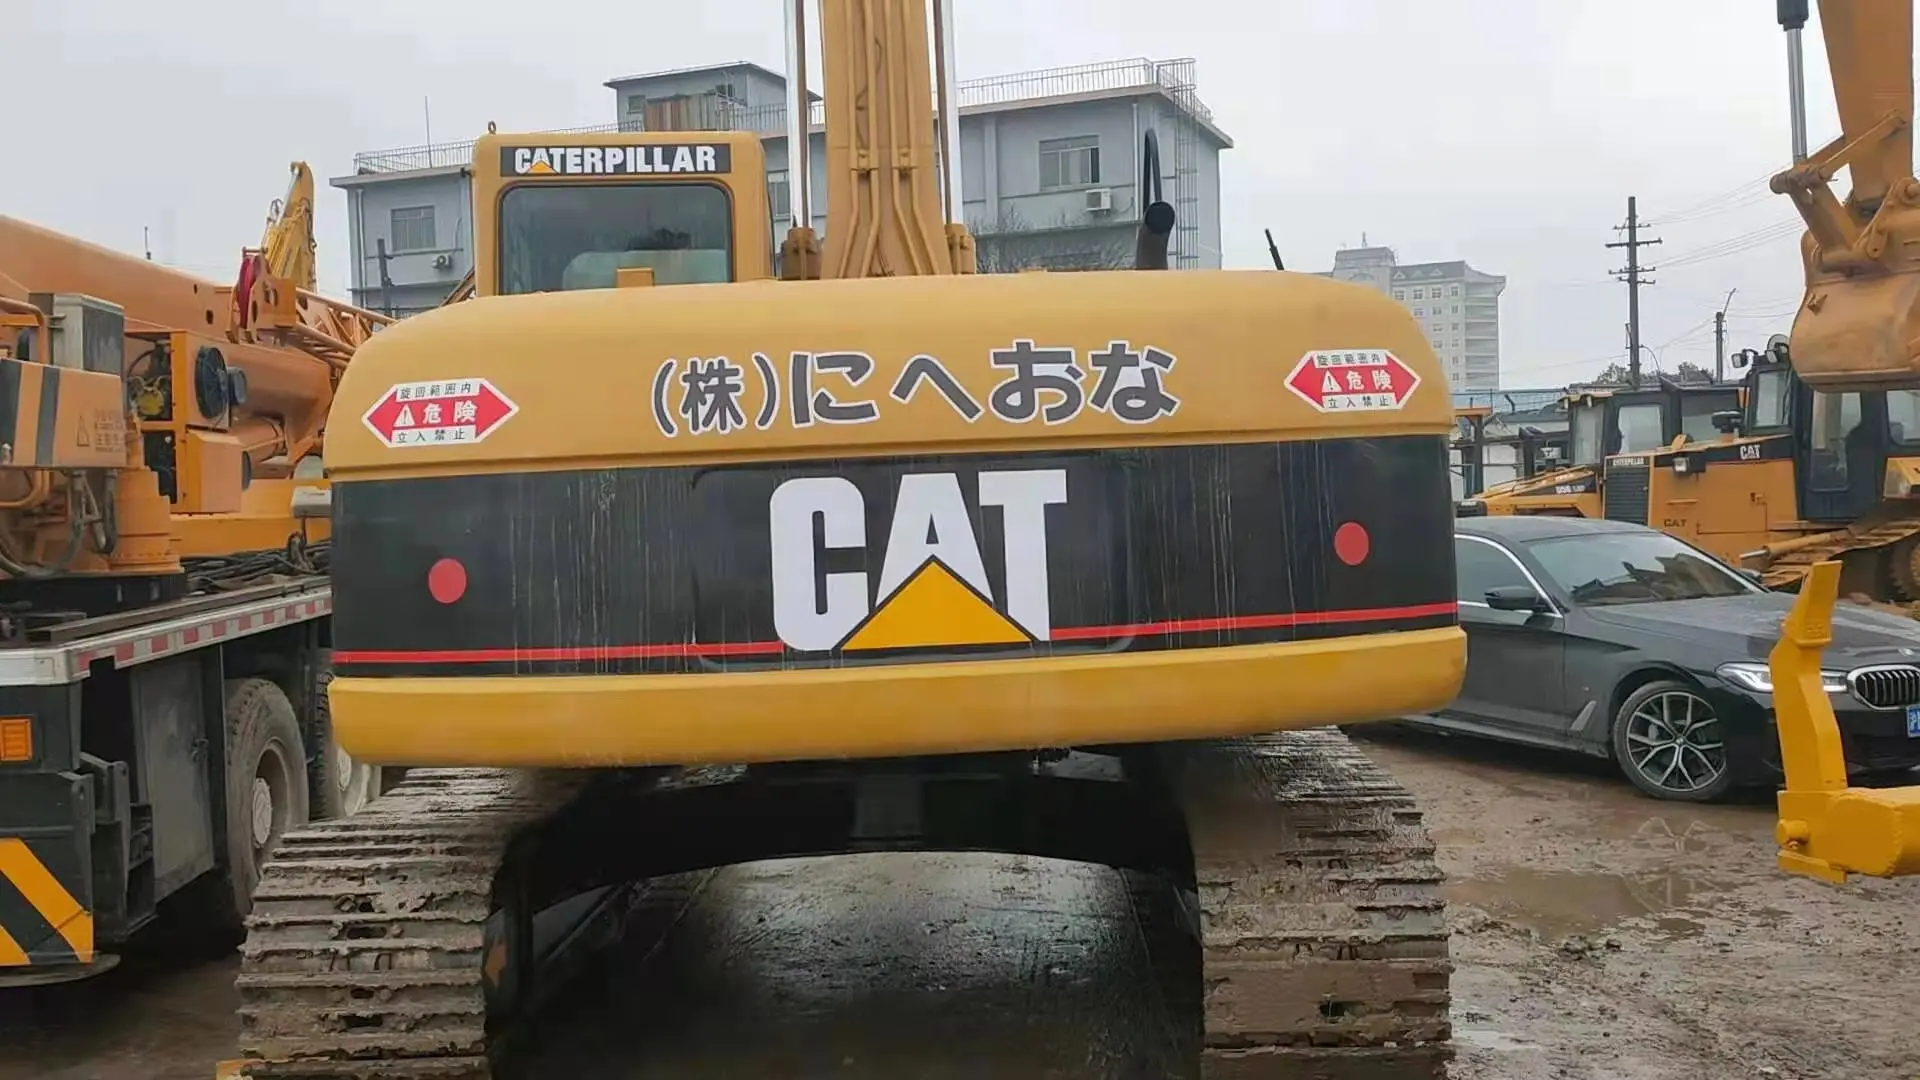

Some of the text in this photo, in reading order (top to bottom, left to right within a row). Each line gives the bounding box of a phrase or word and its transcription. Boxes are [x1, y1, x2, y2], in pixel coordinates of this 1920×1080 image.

[514, 145, 716, 174] CATERPILLAR
[1346, 369, 1393, 391] 危険
[422, 400, 478, 424] 危険
[1328, 396, 1389, 409] 立入禁止
[397, 428, 466, 444] 立入禁止
[1740, 444, 1761, 460] CAT
[1663, 519, 1687, 528] CAT
[769, 468, 1068, 651] CAT
